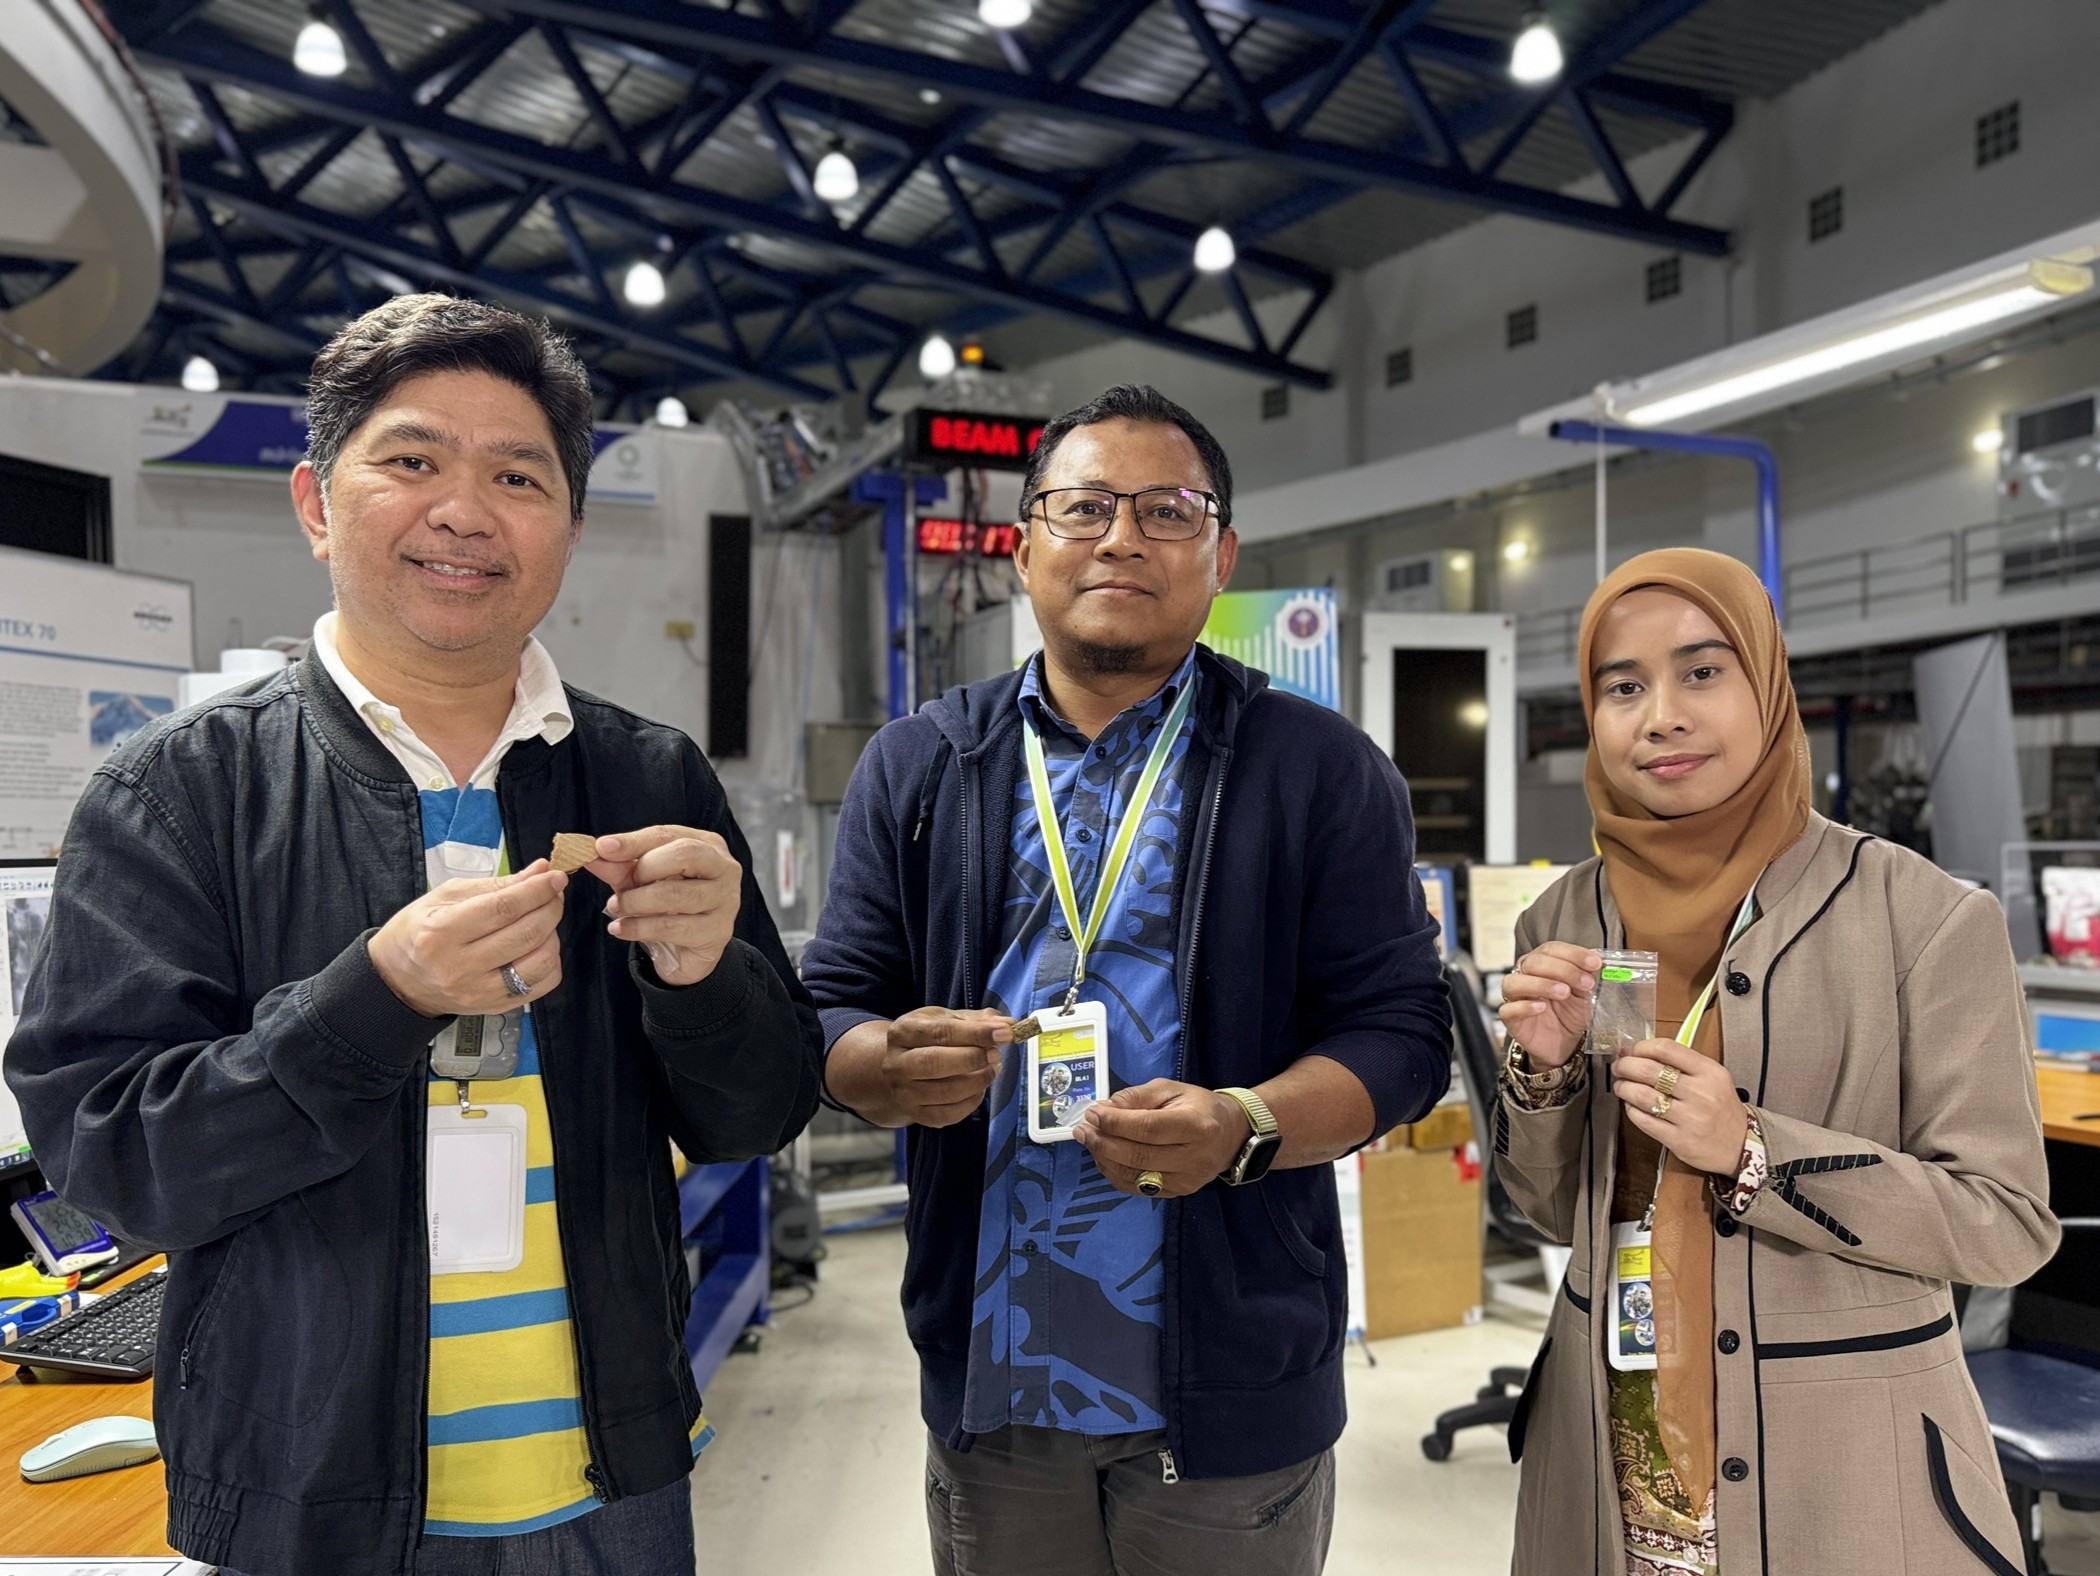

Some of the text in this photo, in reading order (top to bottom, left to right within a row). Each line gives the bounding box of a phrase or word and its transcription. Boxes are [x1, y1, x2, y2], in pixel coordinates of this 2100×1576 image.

[931, 417, 1019, 457] BEAM
[39, 625, 57, 641] 70
[1071, 1061, 1095, 1071] USER
